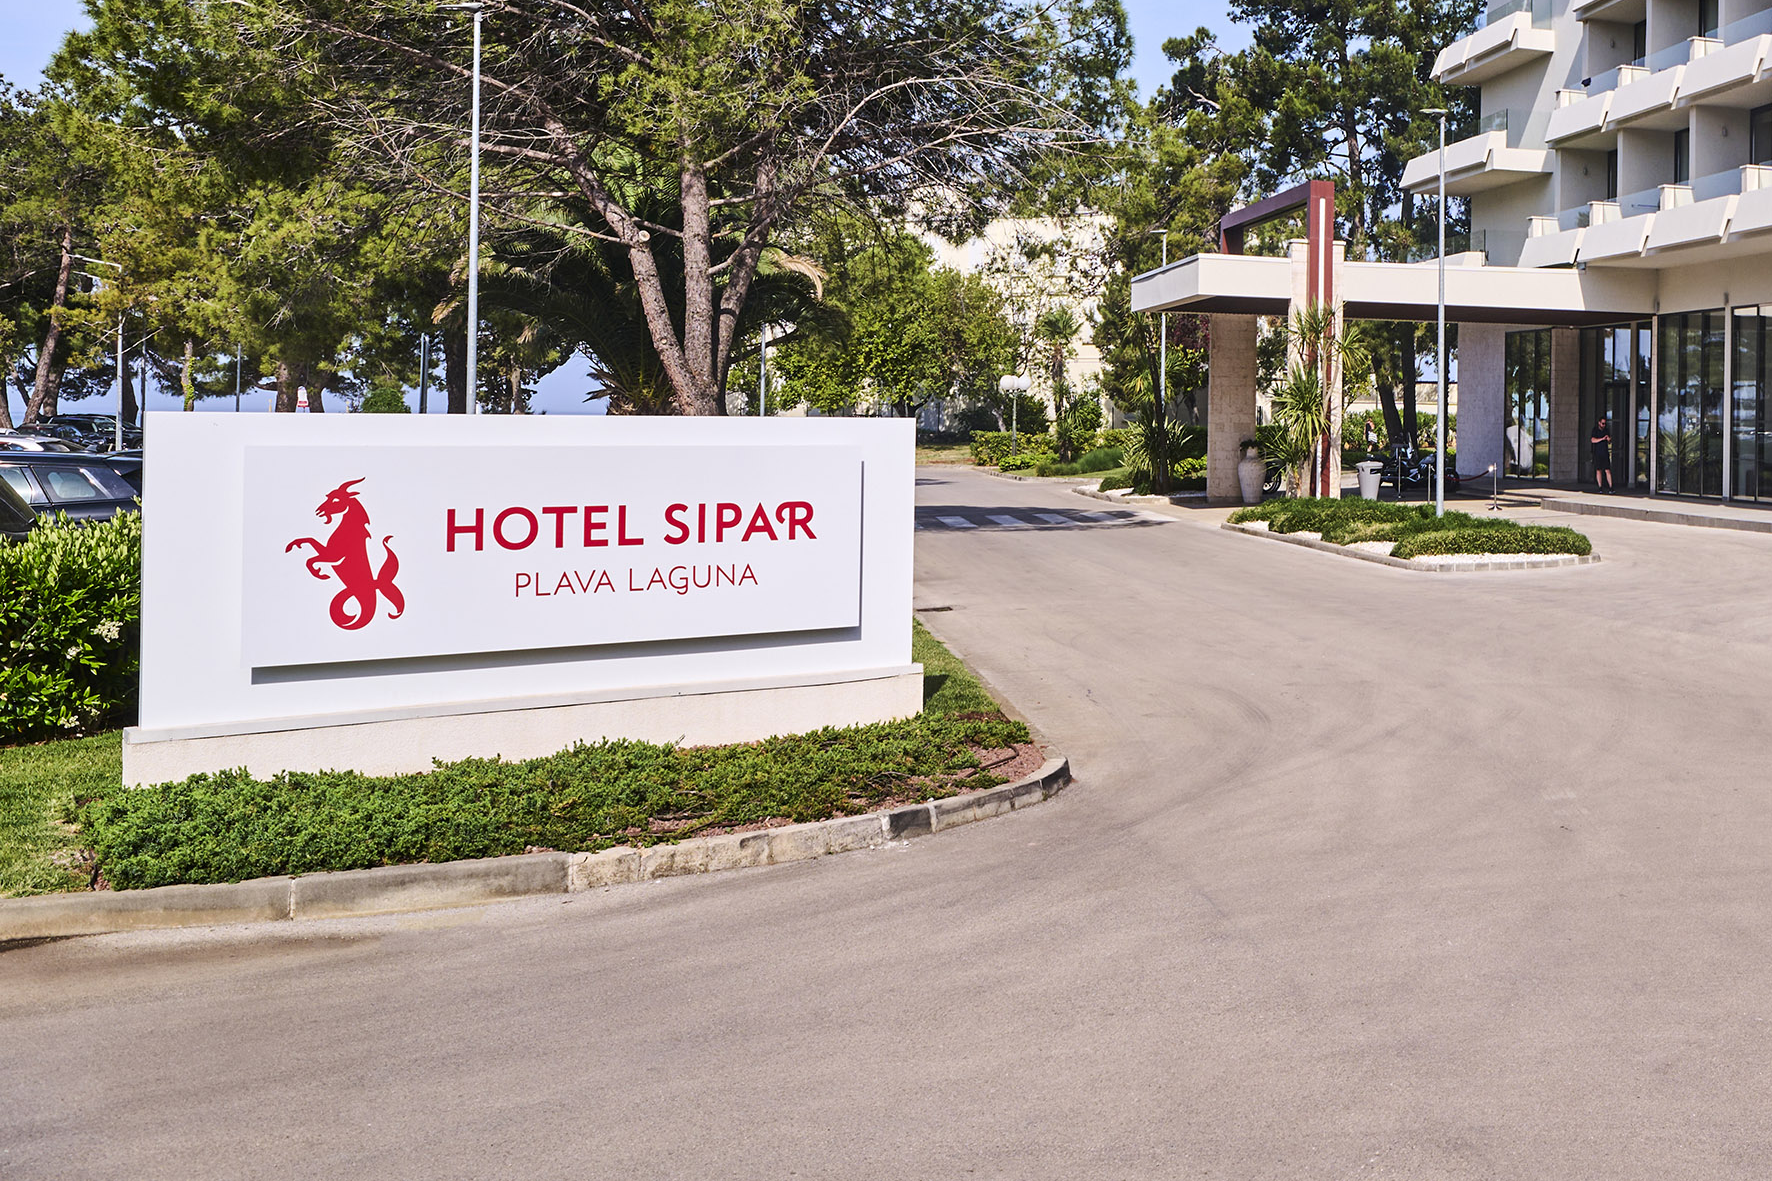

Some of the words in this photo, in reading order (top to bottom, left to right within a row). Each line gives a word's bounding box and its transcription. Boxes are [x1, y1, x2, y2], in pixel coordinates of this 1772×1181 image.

[446, 504, 645, 553] HOTEL
[663, 500, 818, 545] SIPAR
[515, 569, 616, 598] PLAVA
[629, 563, 759, 595] LAGUNA
